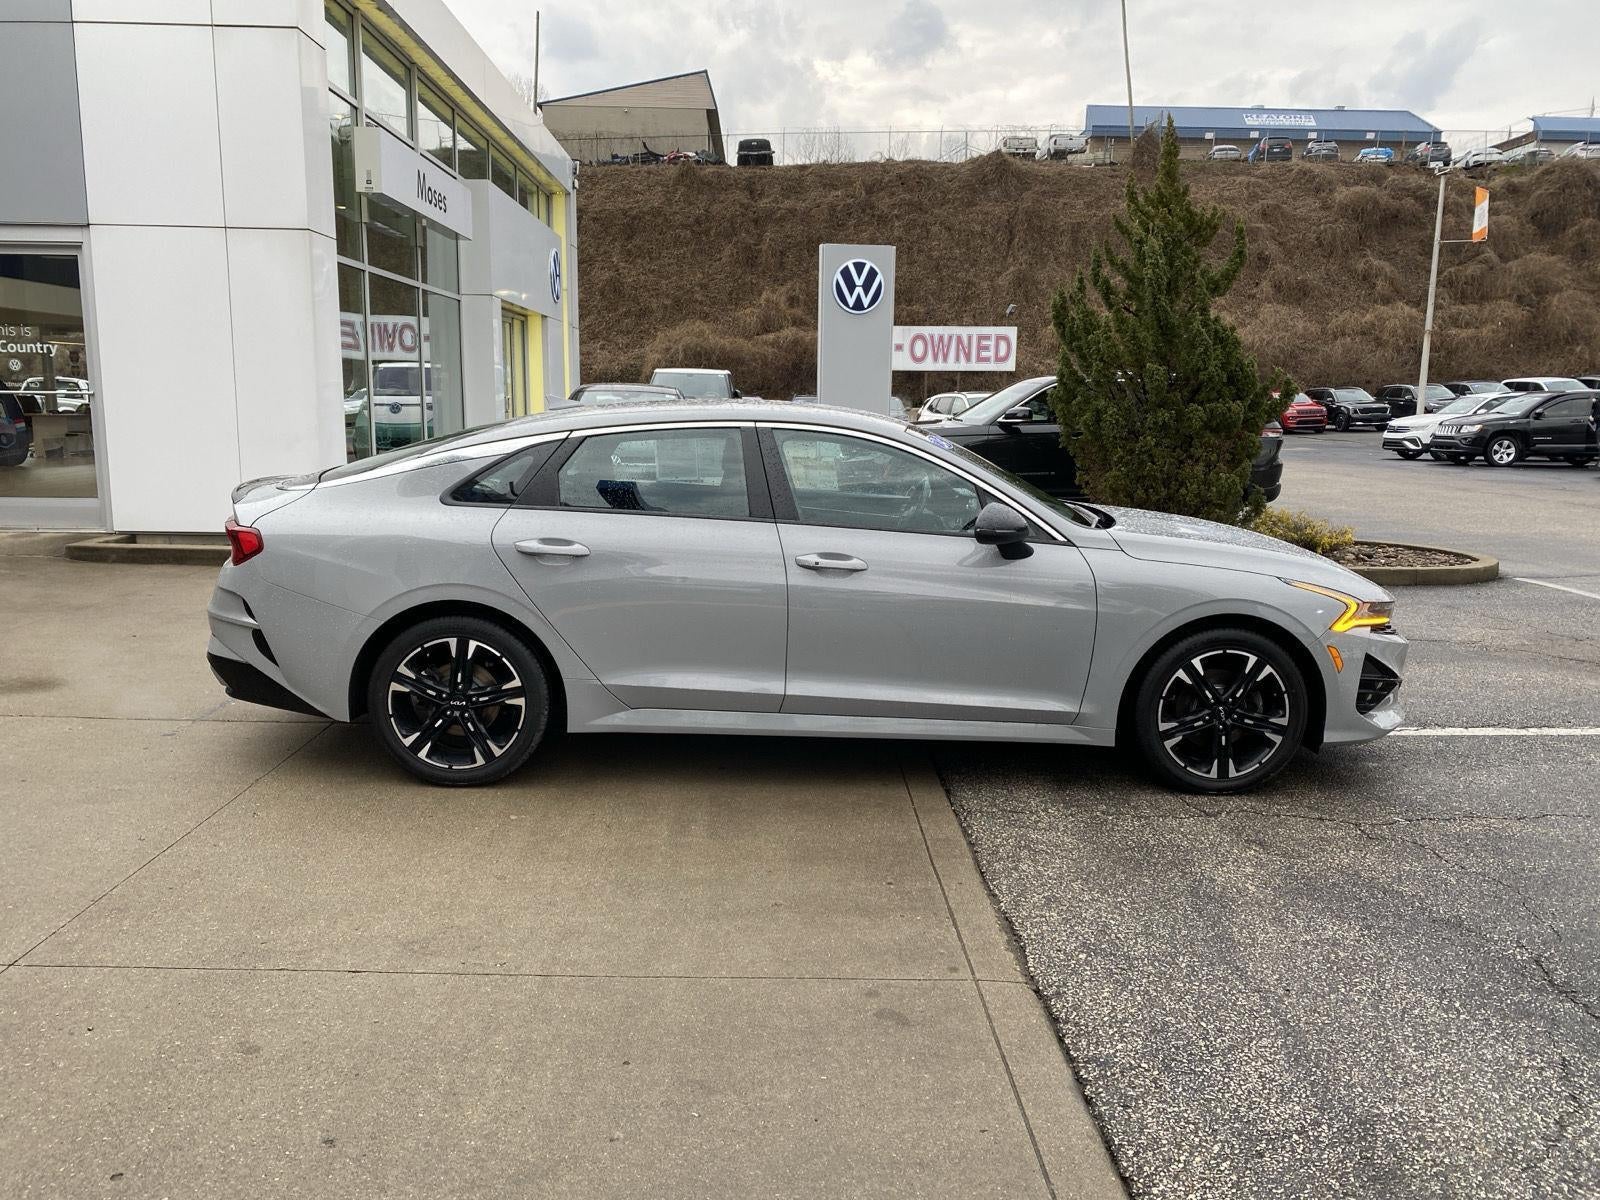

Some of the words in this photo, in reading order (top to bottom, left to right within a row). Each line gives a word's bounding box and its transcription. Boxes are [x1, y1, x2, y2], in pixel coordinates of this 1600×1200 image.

[416, 169, 447, 213] Moses
[835, 260, 883, 311] VW
[20, 323, 32, 337] is
